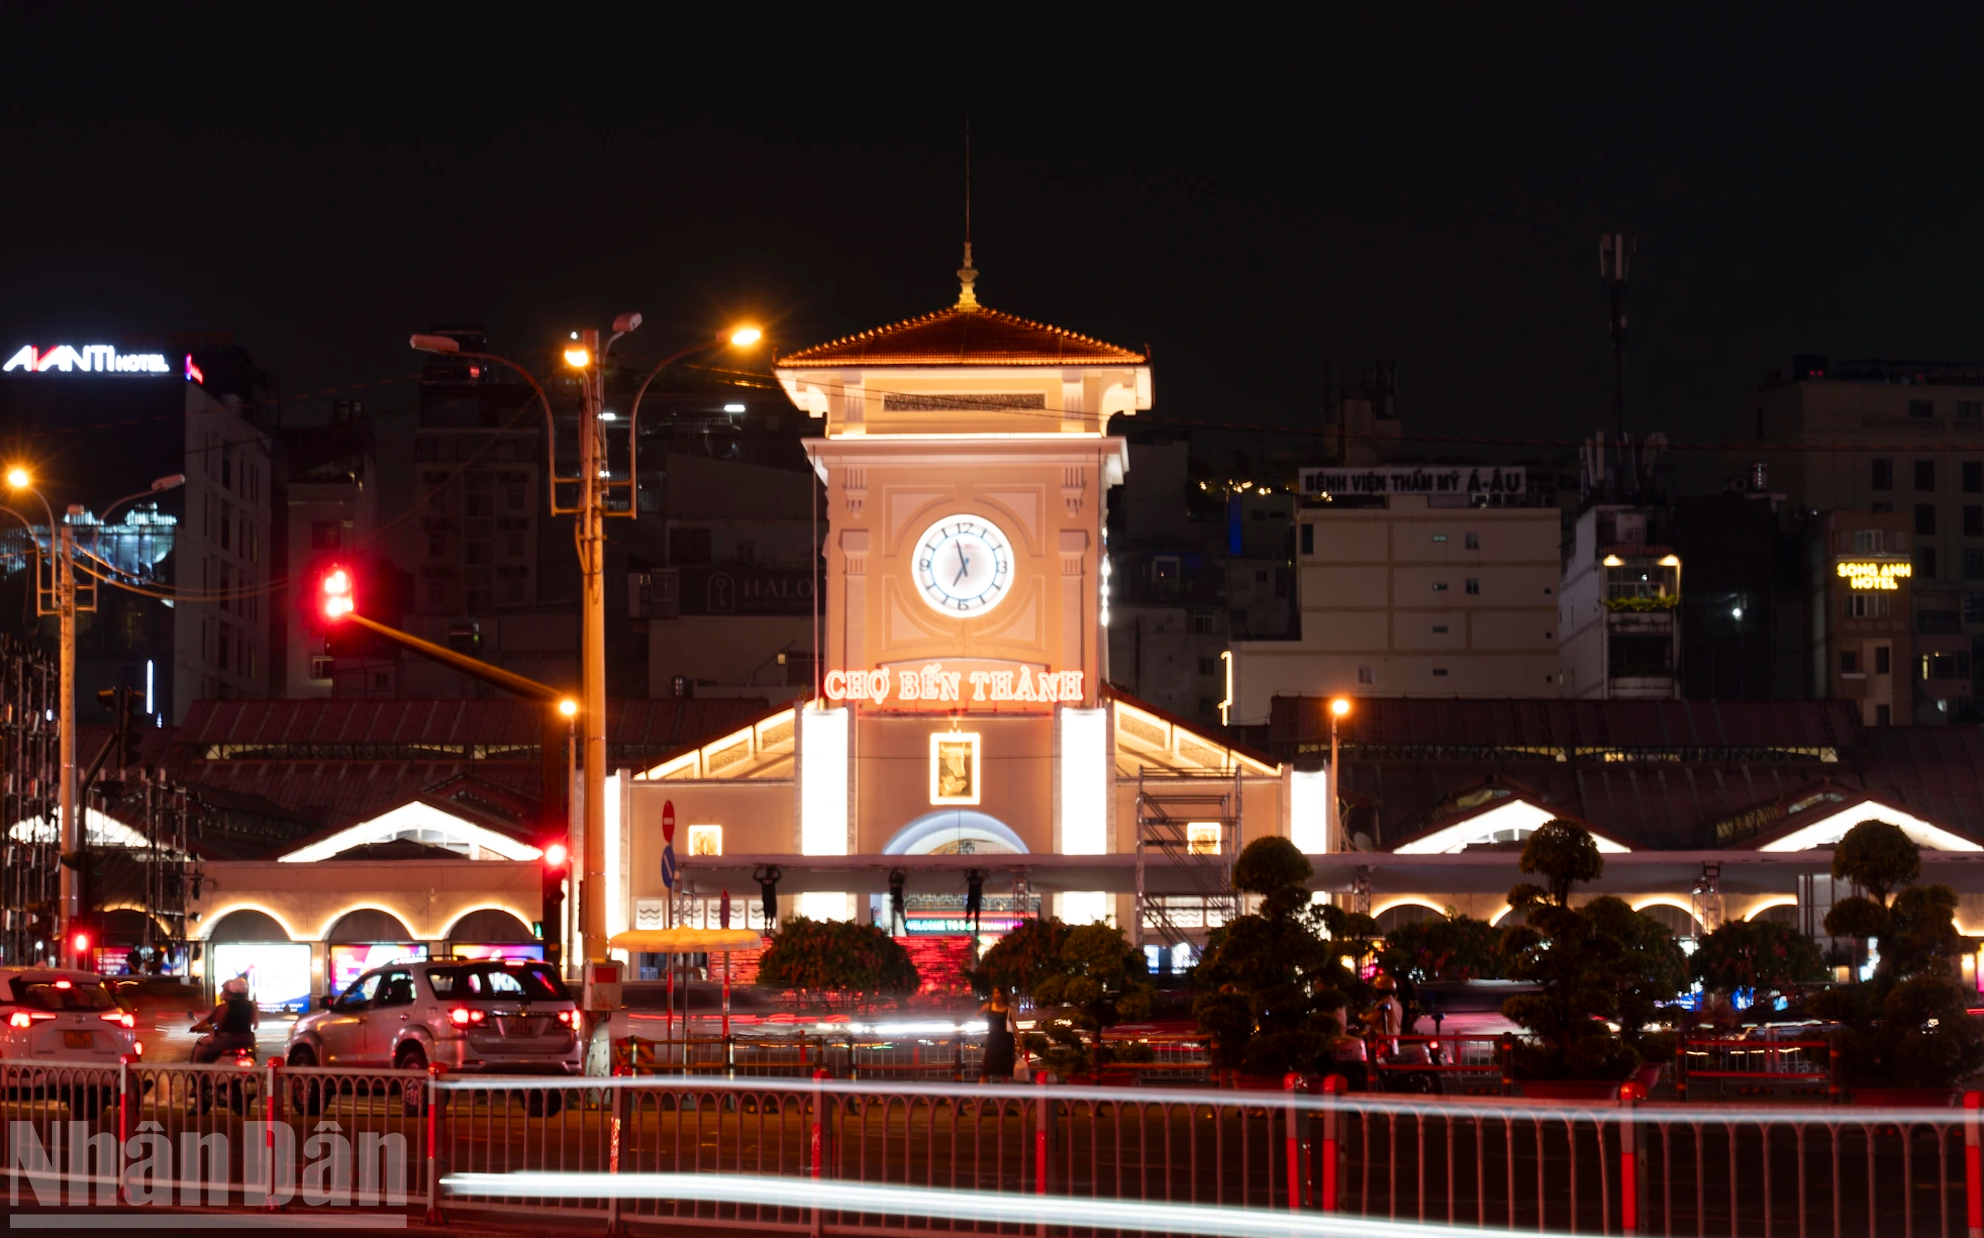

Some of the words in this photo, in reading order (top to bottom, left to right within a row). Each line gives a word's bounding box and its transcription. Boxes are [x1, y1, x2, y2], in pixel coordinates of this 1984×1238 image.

[2, 344, 115, 372] AVANTI
[115, 354, 171, 372] HOTEL
[1352, 471, 1387, 494] VIỆN
[1438, 470, 1460, 492] MỸ
[956, 522, 974, 534] 12
[918, 558, 931, 572] 9
[995, 560, 1008, 575] 3
[1836, 562, 1879, 577] SONG
[1880, 563, 1912, 577] ANH
[1850, 576, 1899, 590] HOTEL
[957, 598, 970, 611] 6
[824, 667, 890, 704] CHỢ
[899, 663, 961, 701] BẾN
[969, 664, 1085, 702] THÀNH
